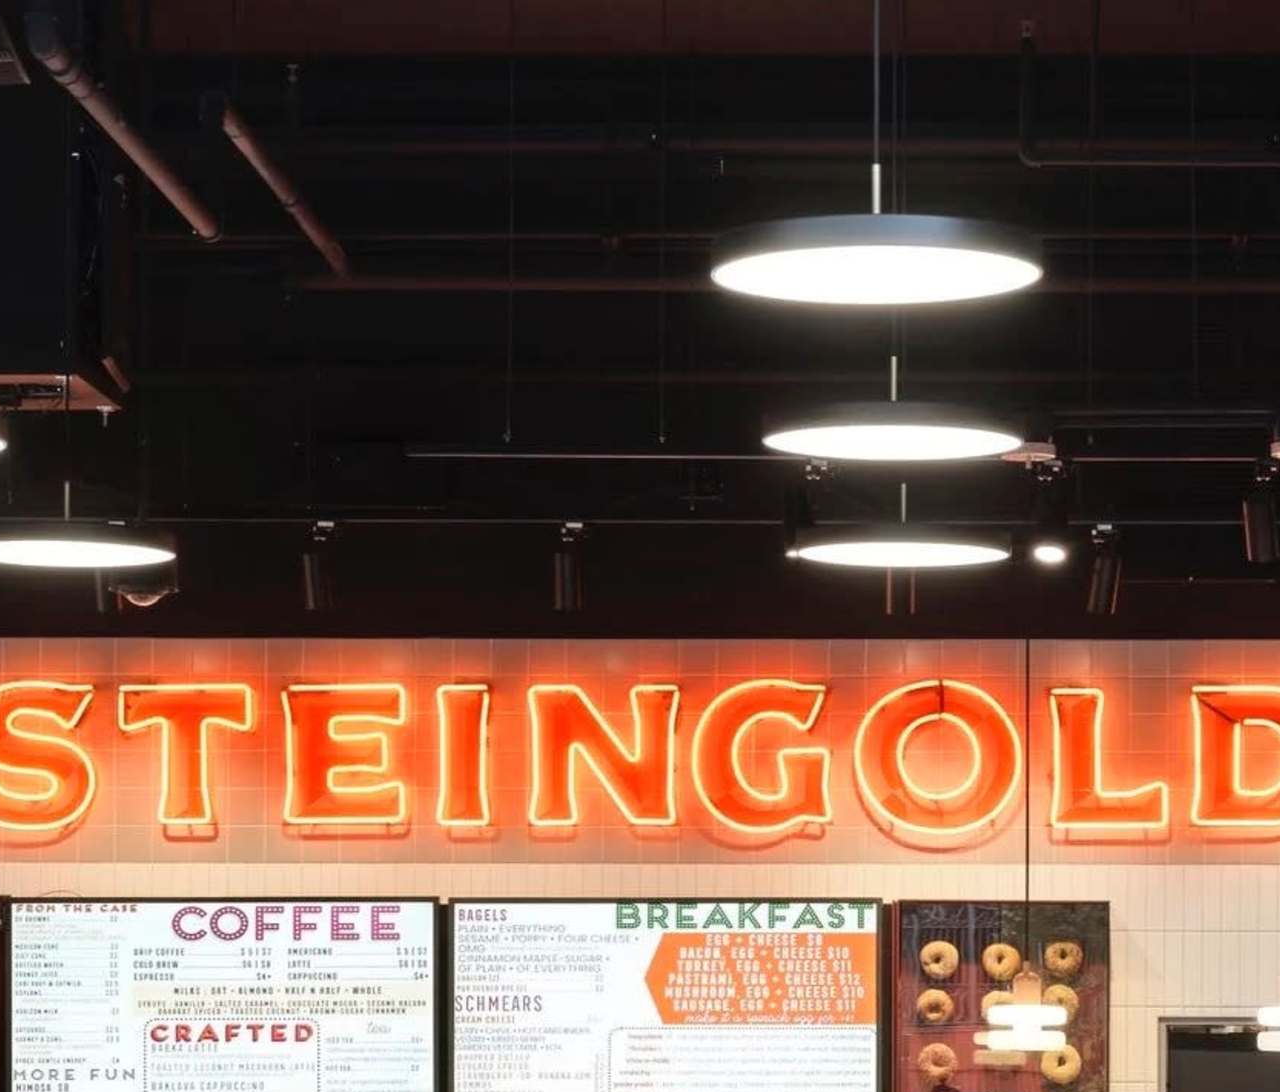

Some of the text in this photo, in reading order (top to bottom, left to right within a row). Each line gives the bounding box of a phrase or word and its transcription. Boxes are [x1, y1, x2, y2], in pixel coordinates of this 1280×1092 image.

[15, 904, 139, 913] FROM THE CASE
[458, 908, 508, 922] BAGELS
[616, 903, 874, 930] BREAKFAST
[171, 905, 401, 941] COFFEE
[457, 924, 566, 934] PLAIN EVERYTHING
[457, 934, 631, 944] SESAME POPPY FOUR CHEESE
[706, 934, 731, 947] EGG
[749, 934, 799, 947] CHEESE
[155, 947, 185, 957] COFFEE
[458, 945, 486, 953] OMG
[731, 946, 755, 960] EGG
[774, 946, 823, 960] CHEESE
[132, 959, 154, 969] COLD
[156, 959, 179, 969] BREW
[287, 959, 312, 969] LATTE
[458, 954, 521, 964] CINNAMON
[475, 964, 602, 974] PLAIN EVERYTHING
[736, 960, 761, 973] EGG
[778, 960, 829, 973] CHEESE
[133, 972, 175, 981] ESPRESSO
[287, 972, 338, 981] CAPPUCCINO
[743, 973, 767, 986] EGG
[785, 973, 835, 986] CHEESE
[351, 986, 383, 995] WHOLE
[746, 986, 770, 1000] EGG
[789, 986, 839, 1000] CHEESE
[455, 995, 544, 1013] SCHMEARS
[740, 1000, 764, 1013] EGG
[782, 1000, 833, 1013] CHEESE
[485, 1015, 516, 1024] CHEESE
[150, 1023, 315, 1043] CRAFTED
[14, 1069, 136, 1081] MORE FUN
[15, 1082, 52, 1092] MIMOSA
